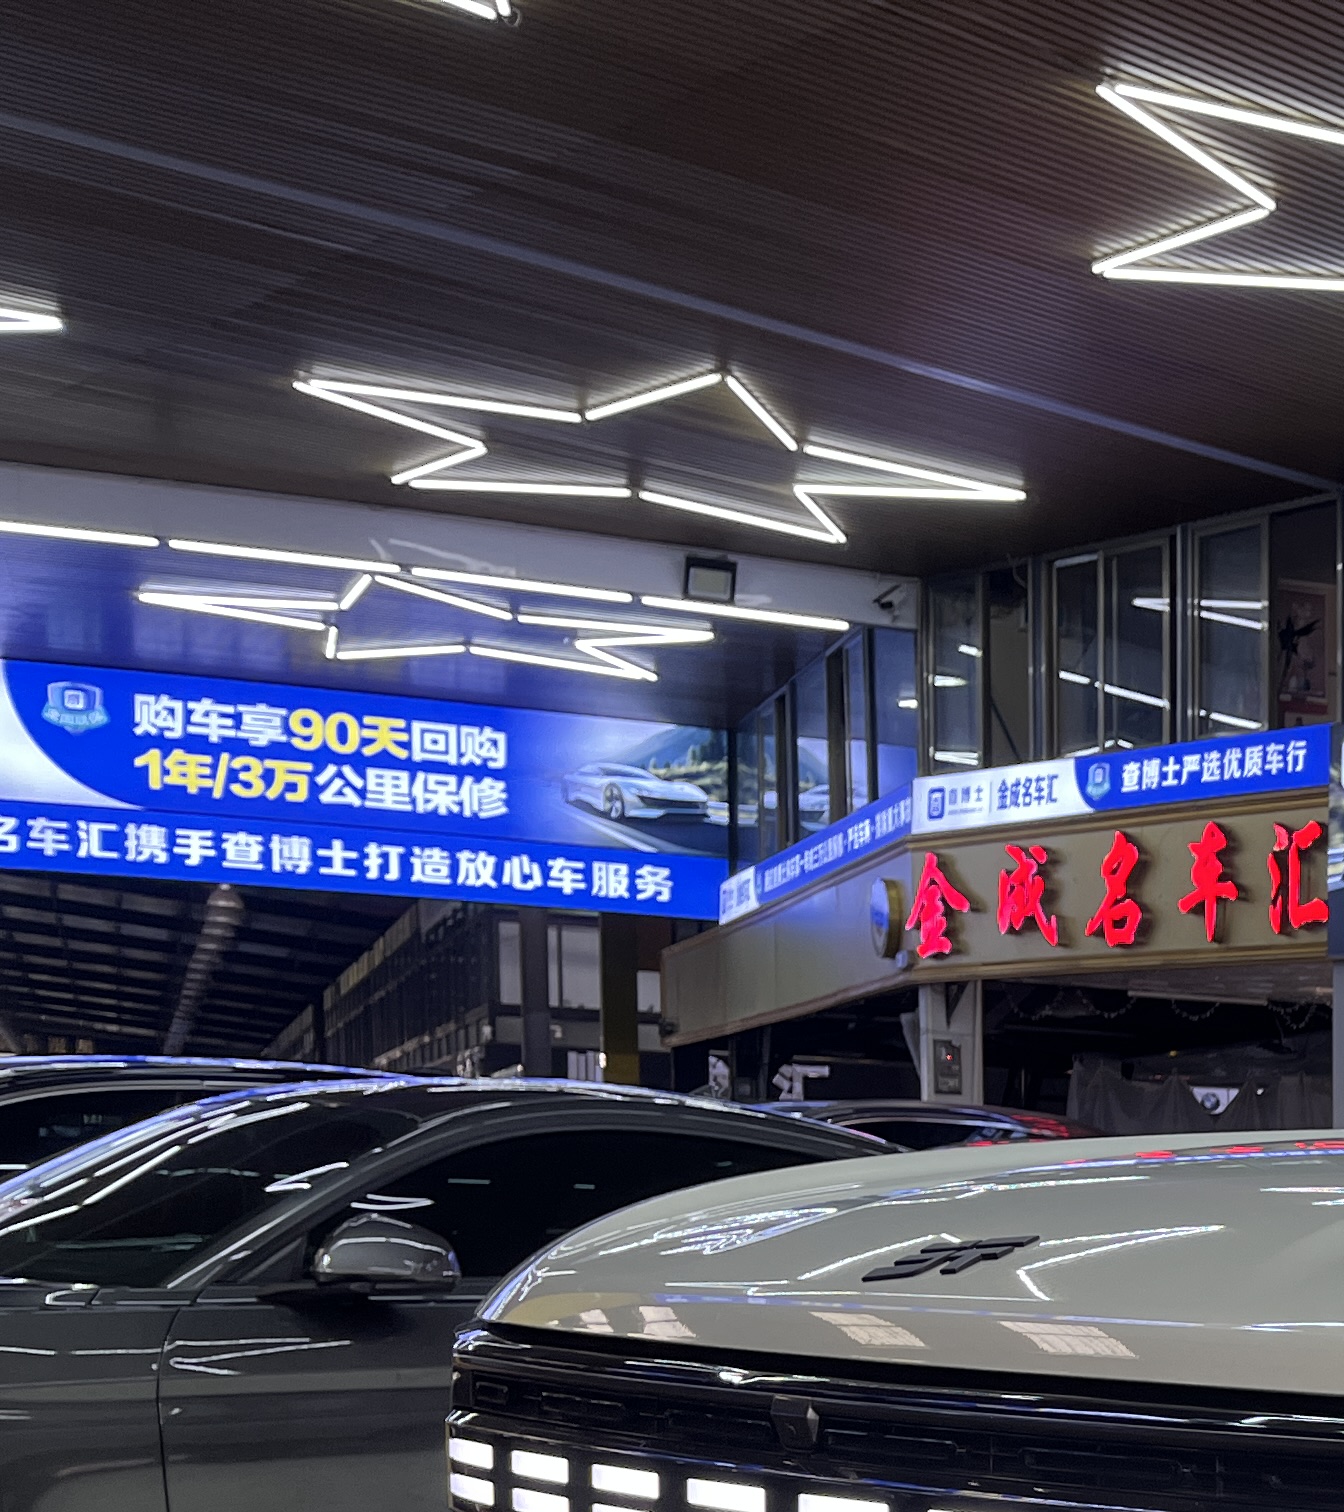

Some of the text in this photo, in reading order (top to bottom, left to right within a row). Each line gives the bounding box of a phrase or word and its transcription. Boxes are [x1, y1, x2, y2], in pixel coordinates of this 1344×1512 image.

[133, 693, 506, 770] 购车享90天回购
[1121, 740, 1308, 793] 查博士严选优质车行
[133, 747, 509, 820] 1年/3万公里保修
